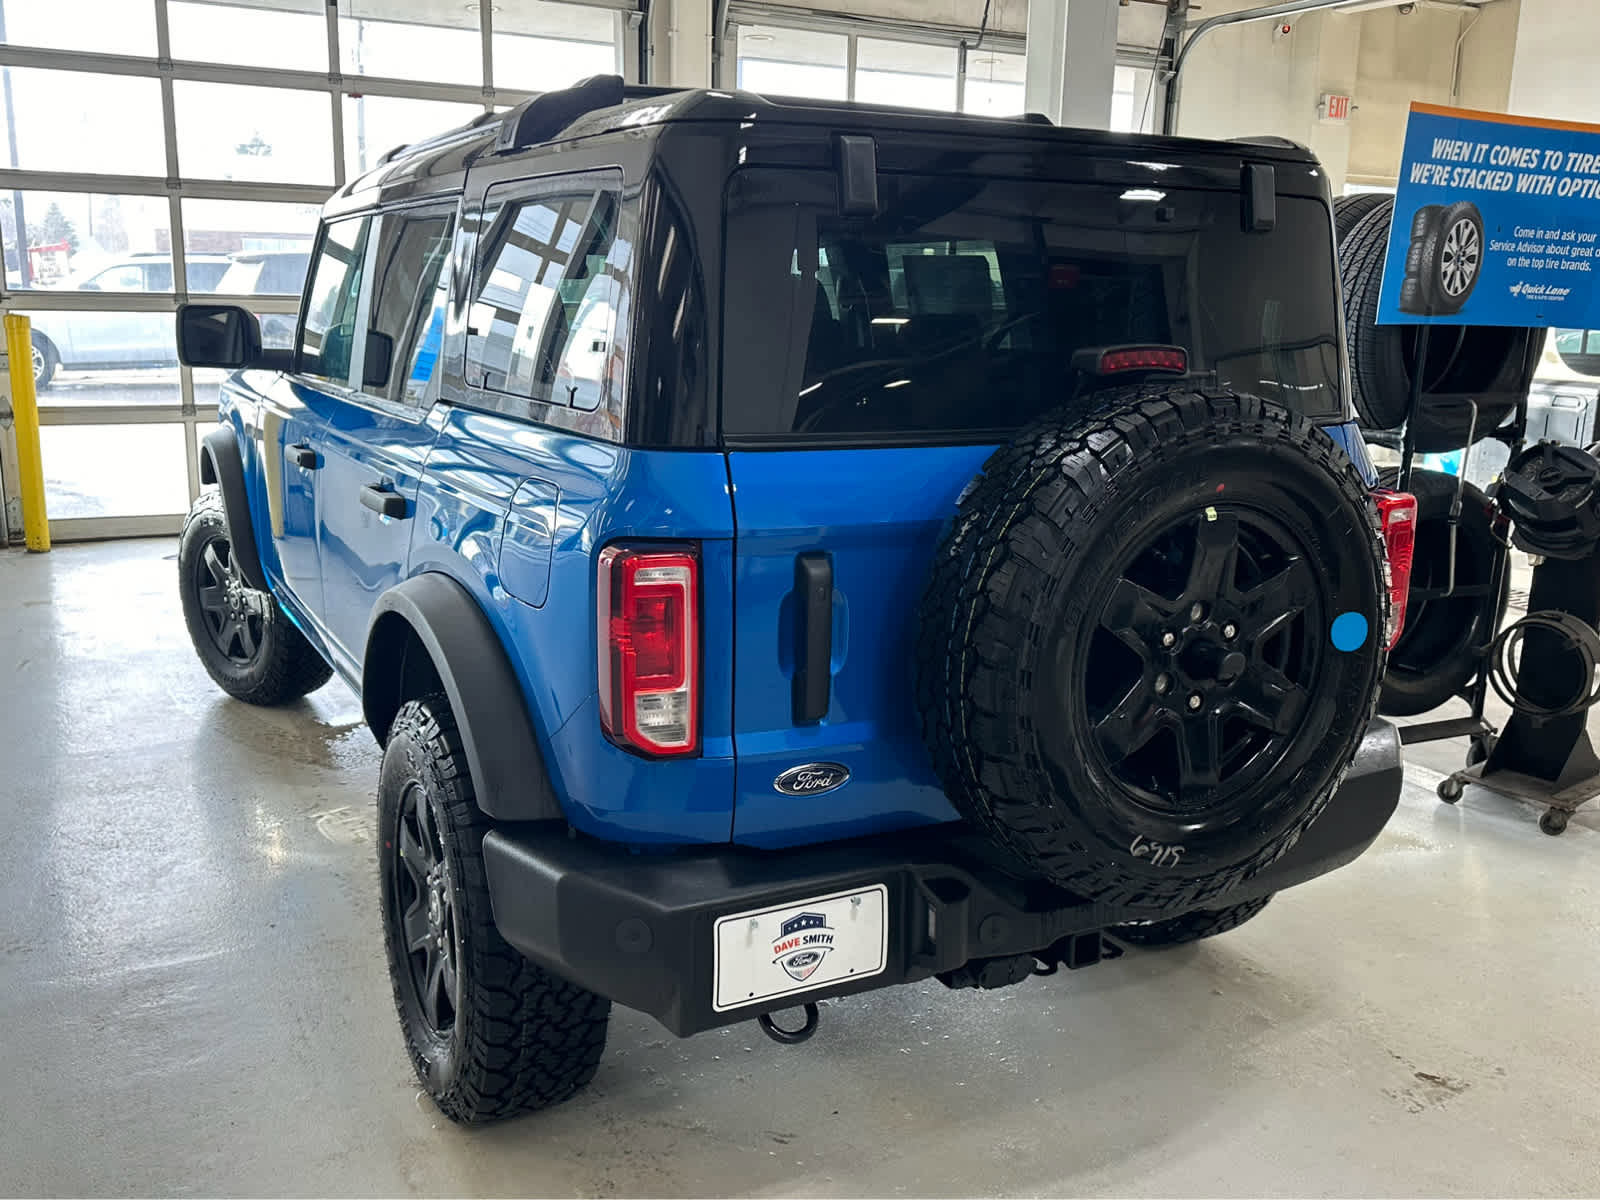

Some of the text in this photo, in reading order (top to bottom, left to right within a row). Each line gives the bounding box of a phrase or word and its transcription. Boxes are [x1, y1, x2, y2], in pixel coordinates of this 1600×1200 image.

[1329, 95, 1349, 118] EXIT
[1431, 137, 1473, 162] WHEN
[1472, 143, 1489, 164] IT
[1489, 145, 1540, 169] COMES
[1542, 150, 1563, 171] TO
[1409, 162, 1452, 186] WE'RE
[1450, 167, 1513, 192] STACKED
[1515, 173, 1556, 196] WITH
[1513, 225, 1597, 244] Come in and ask your
[1489, 239, 1516, 252] Service
[1516, 241, 1545, 254] Advisor
[1545, 243, 1570, 256] about
[1570, 245, 1594, 258] great
[1506, 256, 1592, 272] on the top tire brands.
[1521, 283, 1570, 296] Quick Lane
[793, 770, 834, 791] Ford
[773, 933, 834, 955] DAVE SMITH
